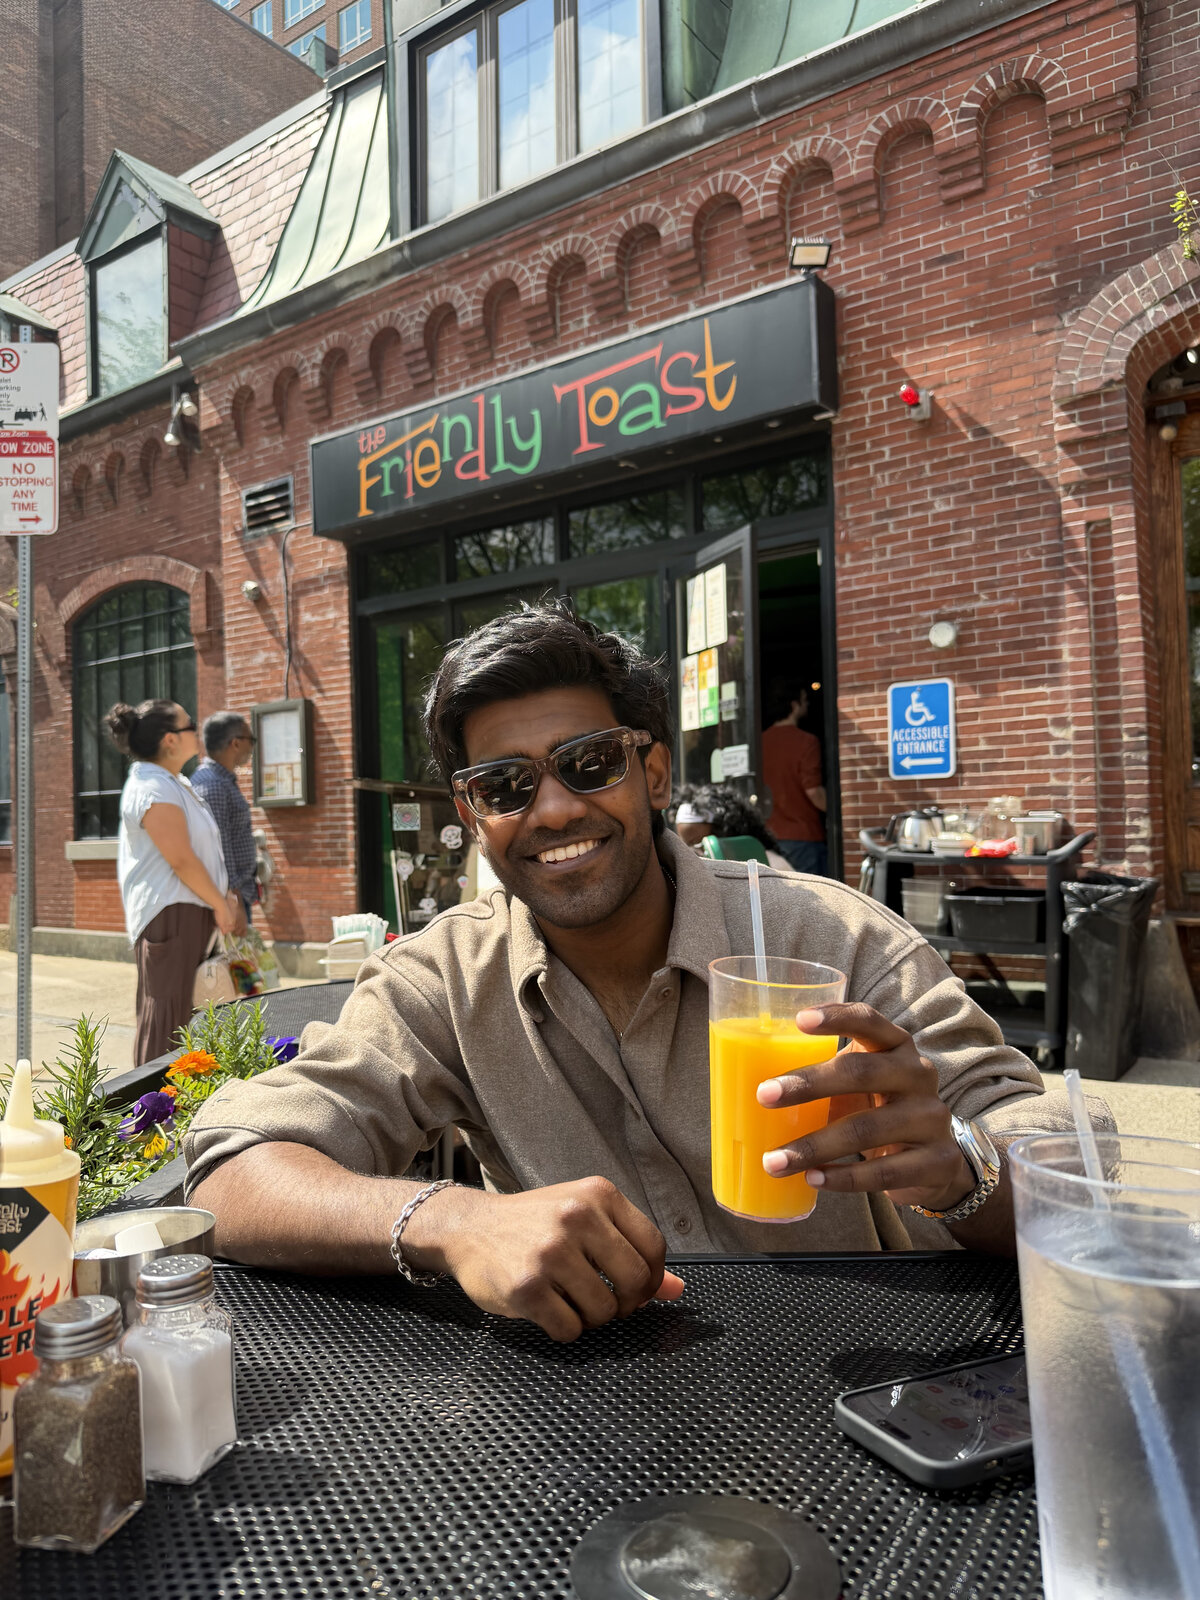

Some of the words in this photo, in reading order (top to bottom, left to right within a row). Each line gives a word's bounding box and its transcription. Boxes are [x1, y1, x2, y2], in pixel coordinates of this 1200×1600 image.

[358, 394, 542, 517] Friendly
[553, 318, 737, 455] Toast
[0, 442, 18, 454] OW
[22, 442, 53, 454] ZONE
[12, 463, 36, 475] NO
[0, 477, 54, 488] STOPPING
[13, 489, 36, 499] ANY
[11, 502, 38, 512] TIME
[893, 725, 949, 742] ACCESSIBLE
[897, 739, 945, 755] ENTRANCE
[0, 1296, 43, 1329] LE
